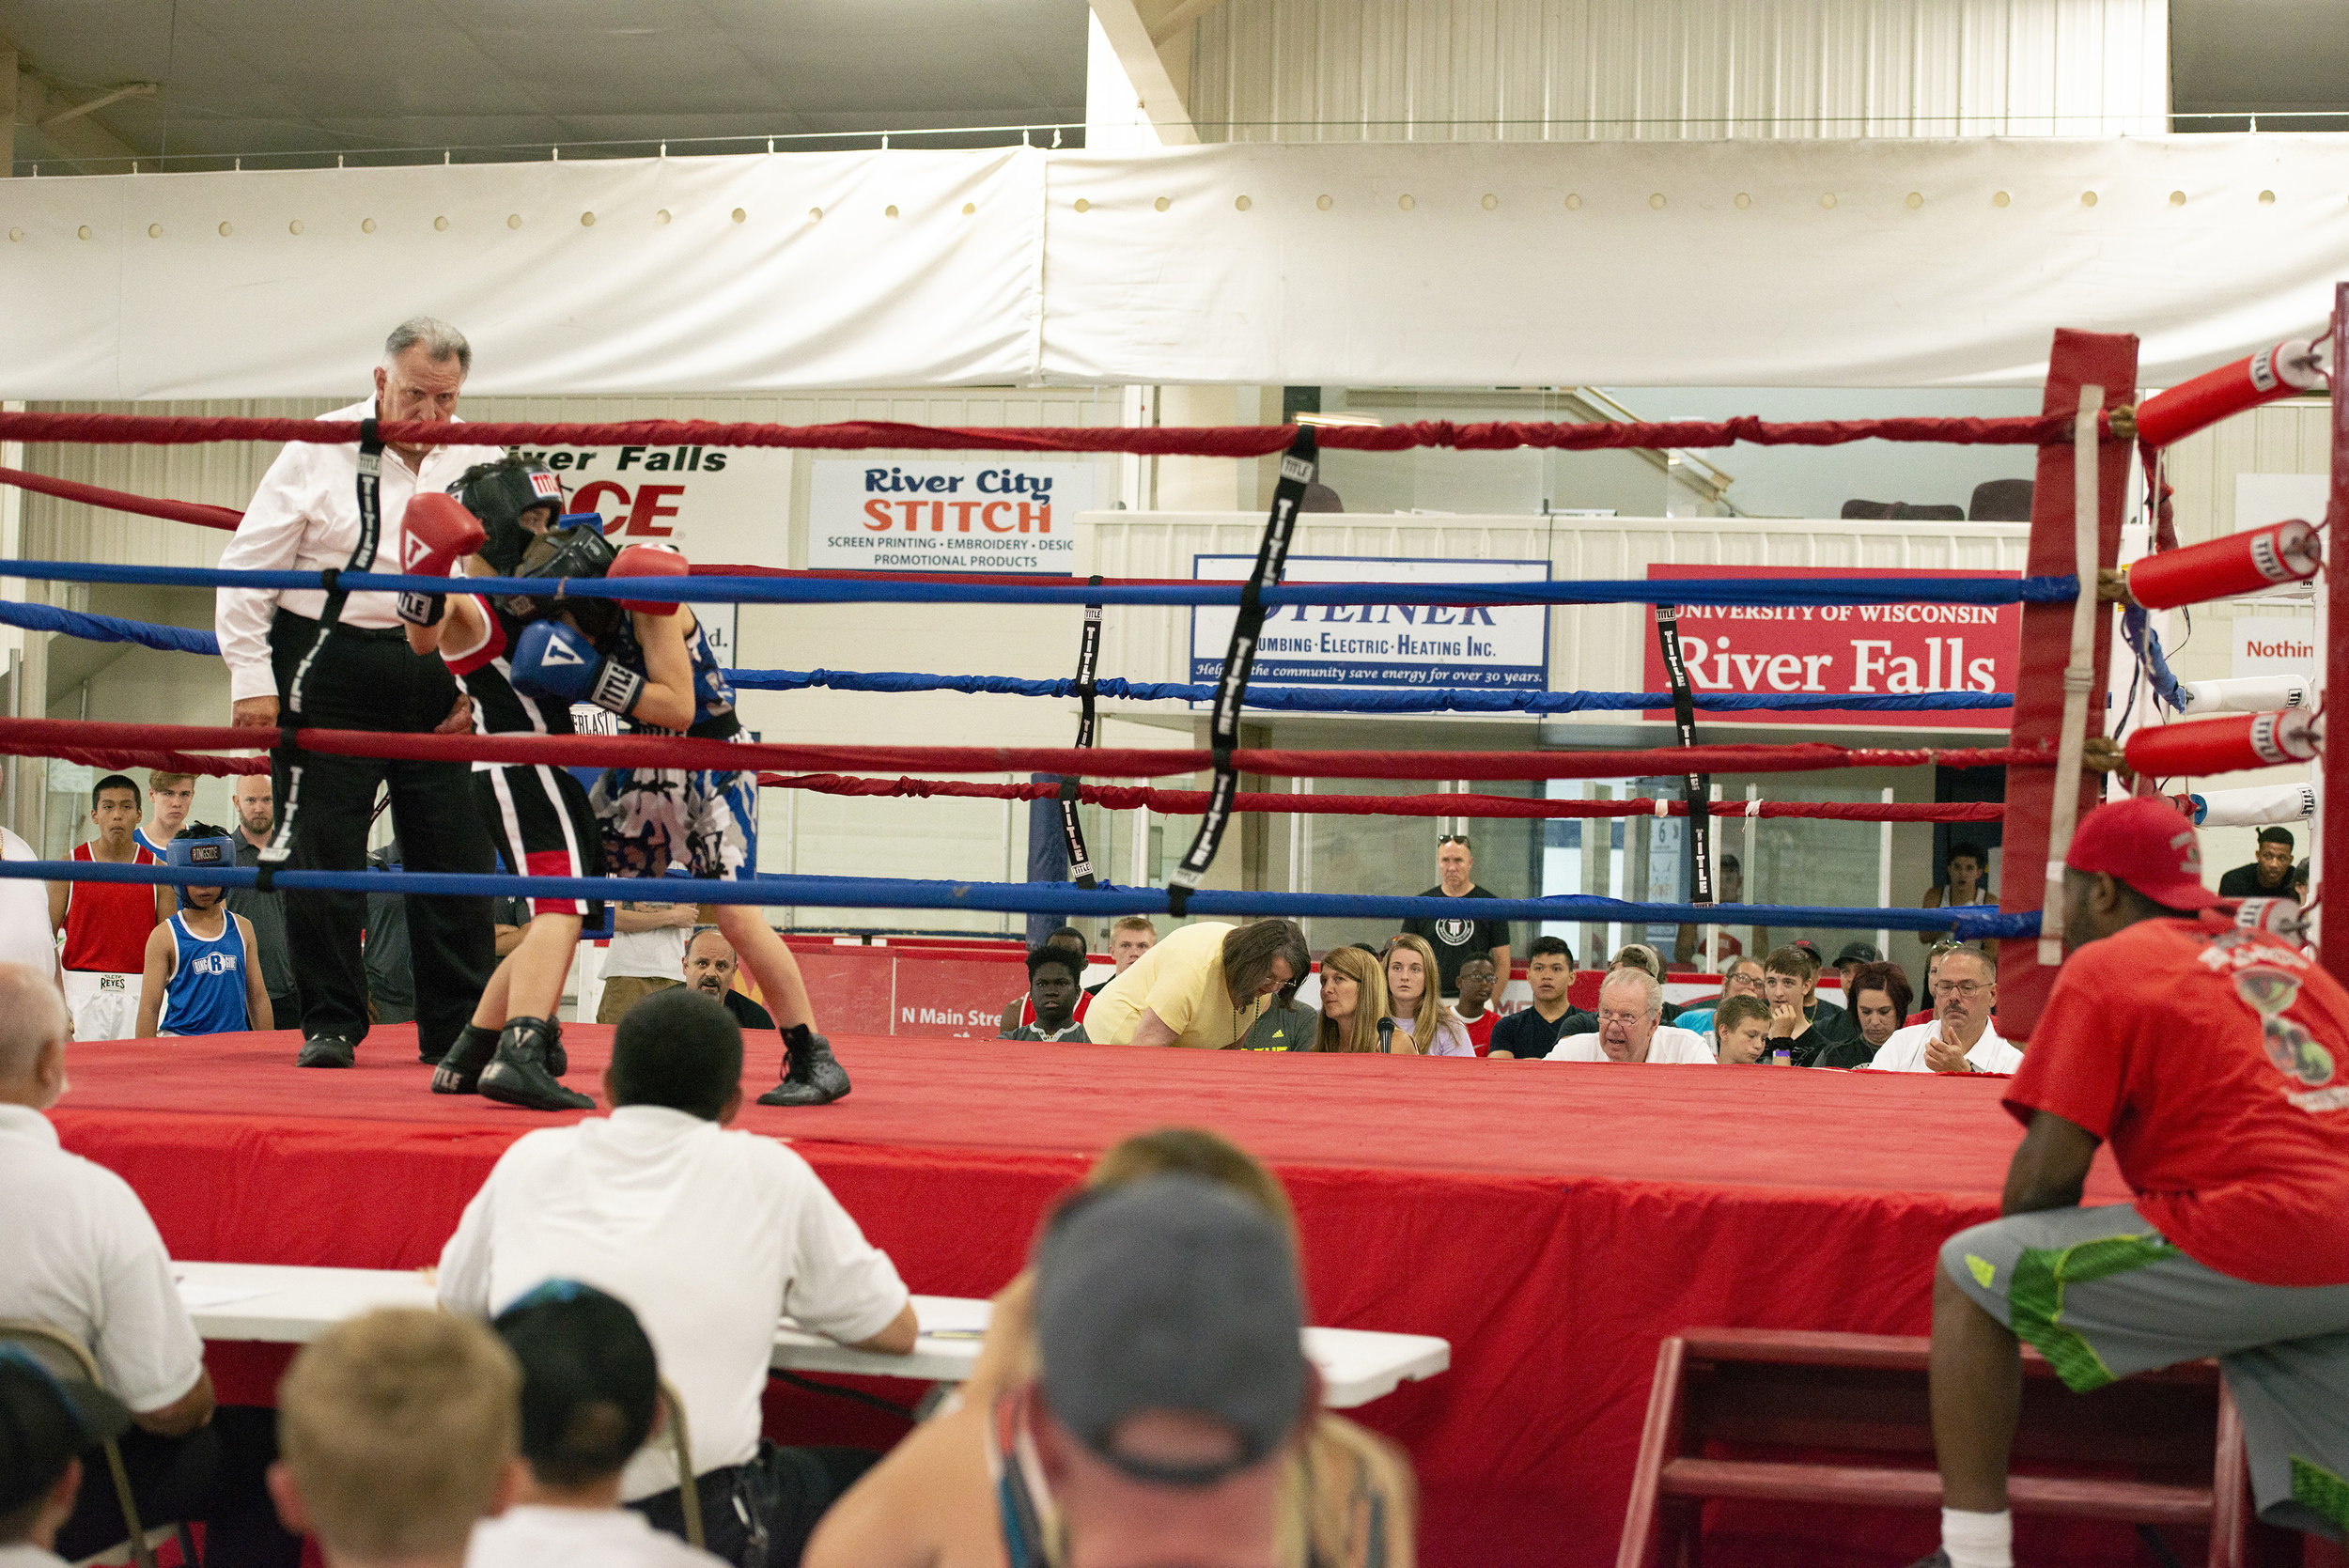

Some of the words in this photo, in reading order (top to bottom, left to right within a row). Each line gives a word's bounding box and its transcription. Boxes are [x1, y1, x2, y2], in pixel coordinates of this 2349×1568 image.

[616, 446, 727, 472] Falls
[864, 467, 964, 493] River
[976, 469, 1052, 505] City
[554, 474, 685, 537] CE
[863, 498, 1051, 534] STITCH
[355, 476, 376, 567] TITLE
[828, 536, 874, 548] SCREEN
[878, 537, 936, 549] PRINTING
[947, 538, 1029, 551] EMBROIDERY
[875, 554, 967, 567] PROMOTIONAL
[971, 556, 1037, 567] PRODUCTS
[1085, 610, 1101, 619] TITLE
[1657, 611, 1674, 619] TITLE
[1674, 604, 1815, 621] UNIVERSITY
[1821, 605, 1853, 621] OF
[1859, 605, 1999, 624] WISCONSIN
[1081, 627, 1096, 685] TITLE
[1664, 630, 1686, 687] TITLE
[1665, 635, 1833, 691] River
[1849, 637, 1996, 694] Falls
[599, 666, 633, 706] TITLE
[1251, 664, 1269, 676] the
[1272, 664, 1346, 682] community
[1349, 668, 1378, 679] save
[1382, 669, 1426, 684] energy
[1428, 667, 1450, 684] for
[1453, 671, 1483, 681] over
[1485, 672, 1501, 683] 30
[1503, 671, 1543, 685] years.
[570, 710, 610, 736] ERLAST
[1063, 800, 1084, 862] TITLE
[193, 846, 218, 862] RINGSIDE
[1695, 829, 1708, 893] TITLE
[1073, 862, 1091, 876] TITLE
[101, 977, 125, 990] REYES
[902, 1007, 915, 1023] N
[920, 1008, 964, 1025] Main
[968, 1010, 1001, 1027] Stre
